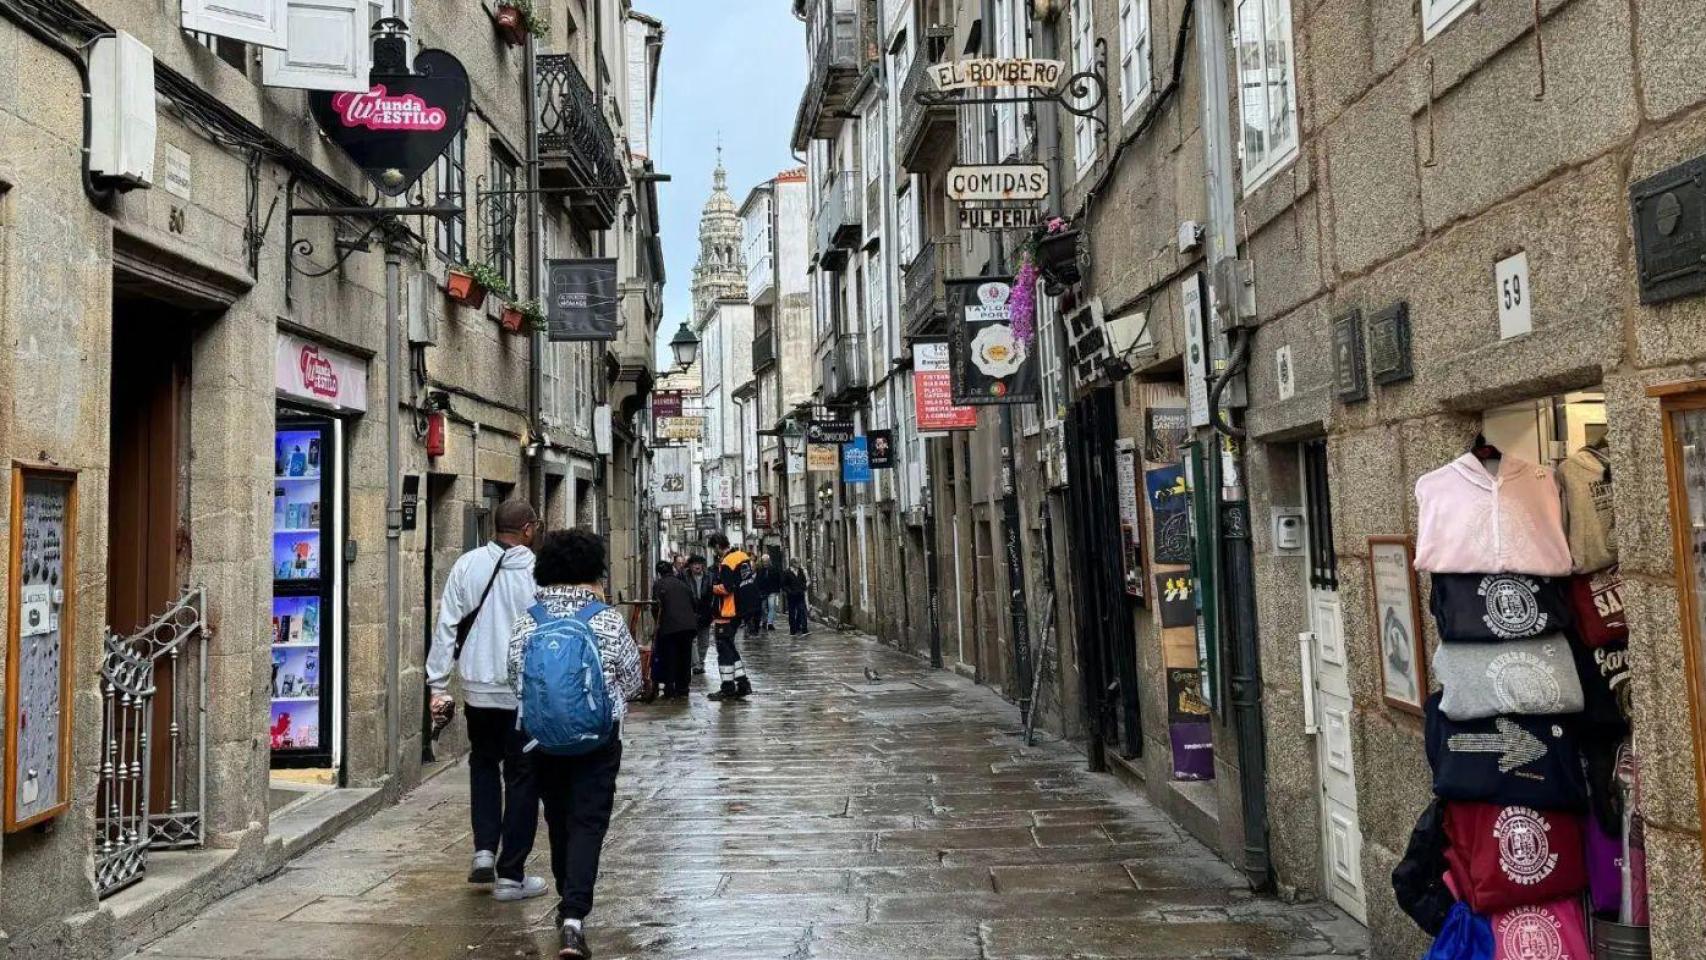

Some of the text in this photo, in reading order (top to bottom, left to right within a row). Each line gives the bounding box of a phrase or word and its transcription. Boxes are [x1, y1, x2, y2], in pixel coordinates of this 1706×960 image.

[938, 62, 1058, 87] EL BOMBERO
[337, 89, 421, 122] Tu funda
[383, 111, 442, 125] ESTILO
[953, 173, 1042, 194] COMIDAS
[168, 204, 185, 235] 50
[959, 209, 1038, 227] PULPERIA
[1503, 264, 1521, 311] 59
[1498, 905, 1561, 933] UNIVERSIDAD
